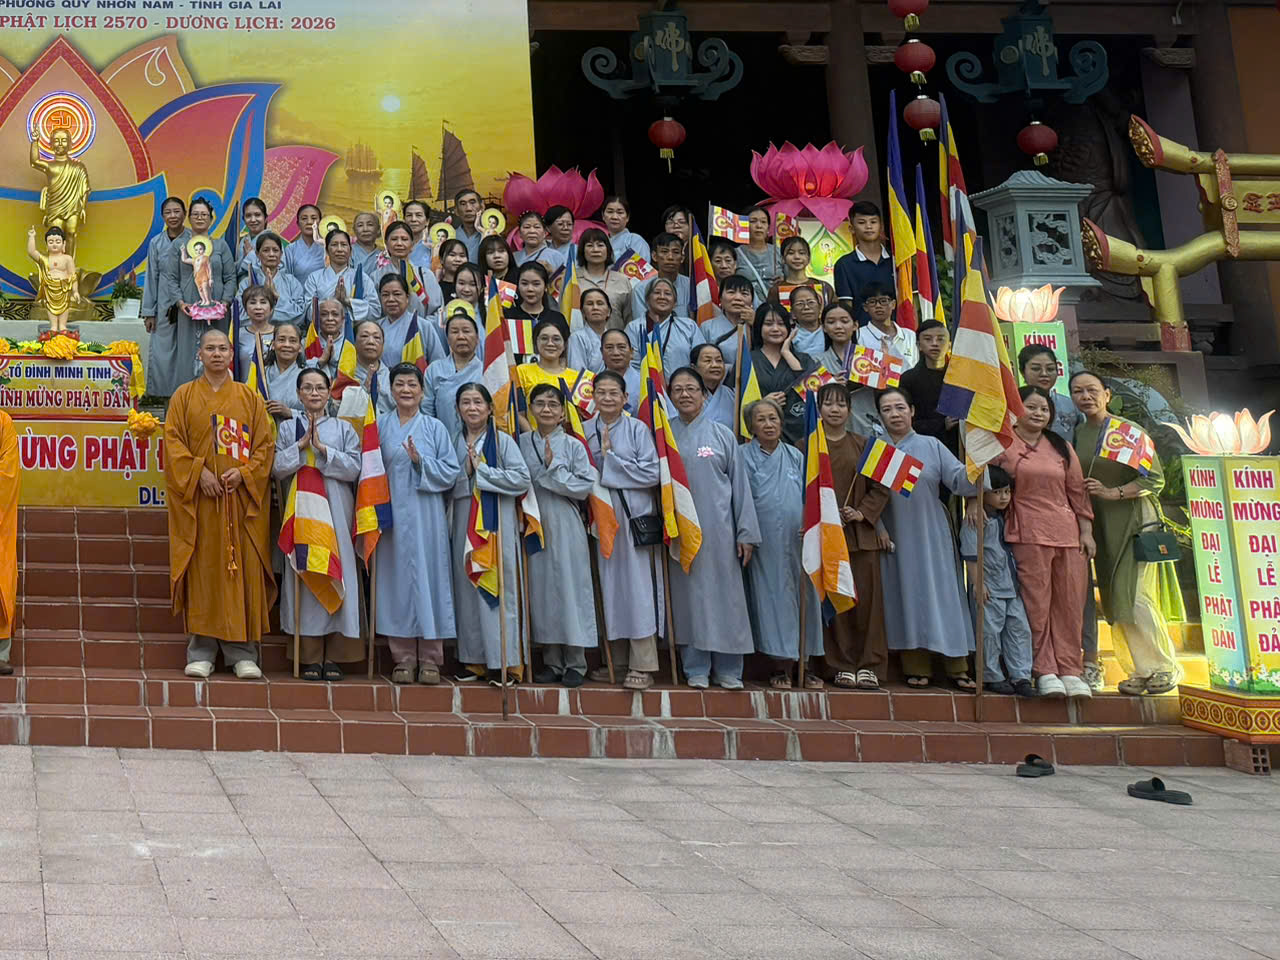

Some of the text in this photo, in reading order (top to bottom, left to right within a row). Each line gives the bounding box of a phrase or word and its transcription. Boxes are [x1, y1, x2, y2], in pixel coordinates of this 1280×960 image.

[61, 0, 91, 9] QUY
[142, 0, 174, 9] NAM
[228, 0, 253, 9] GIA
[259, 1, 282, 9] LAI
[0, 12, 47, 31] PHẬT
[54, 15, 97, 31] LỊCH
[103, 16, 148, 29] 2570
[166, 14, 229, 30] DƯƠNG
[235, 16, 284, 32] LỊCH:
[291, 16, 336, 30] 2026
[25, 364, 51, 378] ĐÌNH
[55, 366, 83, 379] MINH
[86, 367, 112, 381] TỊNH
[26, 385, 62, 407] MỪNG
[66, 386, 100, 411] PHẬT
[103, 384, 130, 408] ĐẢN
[17, 428, 76, 469] ỪNG
[85, 430, 150, 479] PHẬT
[1189, 466, 1216, 488] KÍNH
[1233, 466, 1274, 488] KÍNH
[1190, 497, 1224, 520] MỪNG
[1233, 498, 1280, 521] MỪNG
[1201, 532, 1221, 556] ĐẠI
[1248, 534, 1278, 558] ĐẠI
[1208, 558, 1222, 583] LỄ
[1257, 560, 1278, 586] LỄ
[1204, 594, 1233, 621] PHẬT
[1249, 596, 1280, 624] PHẬ
[1211, 623, 1237, 650] ĐẢN
[1259, 627, 1280, 653] ĐẢ
